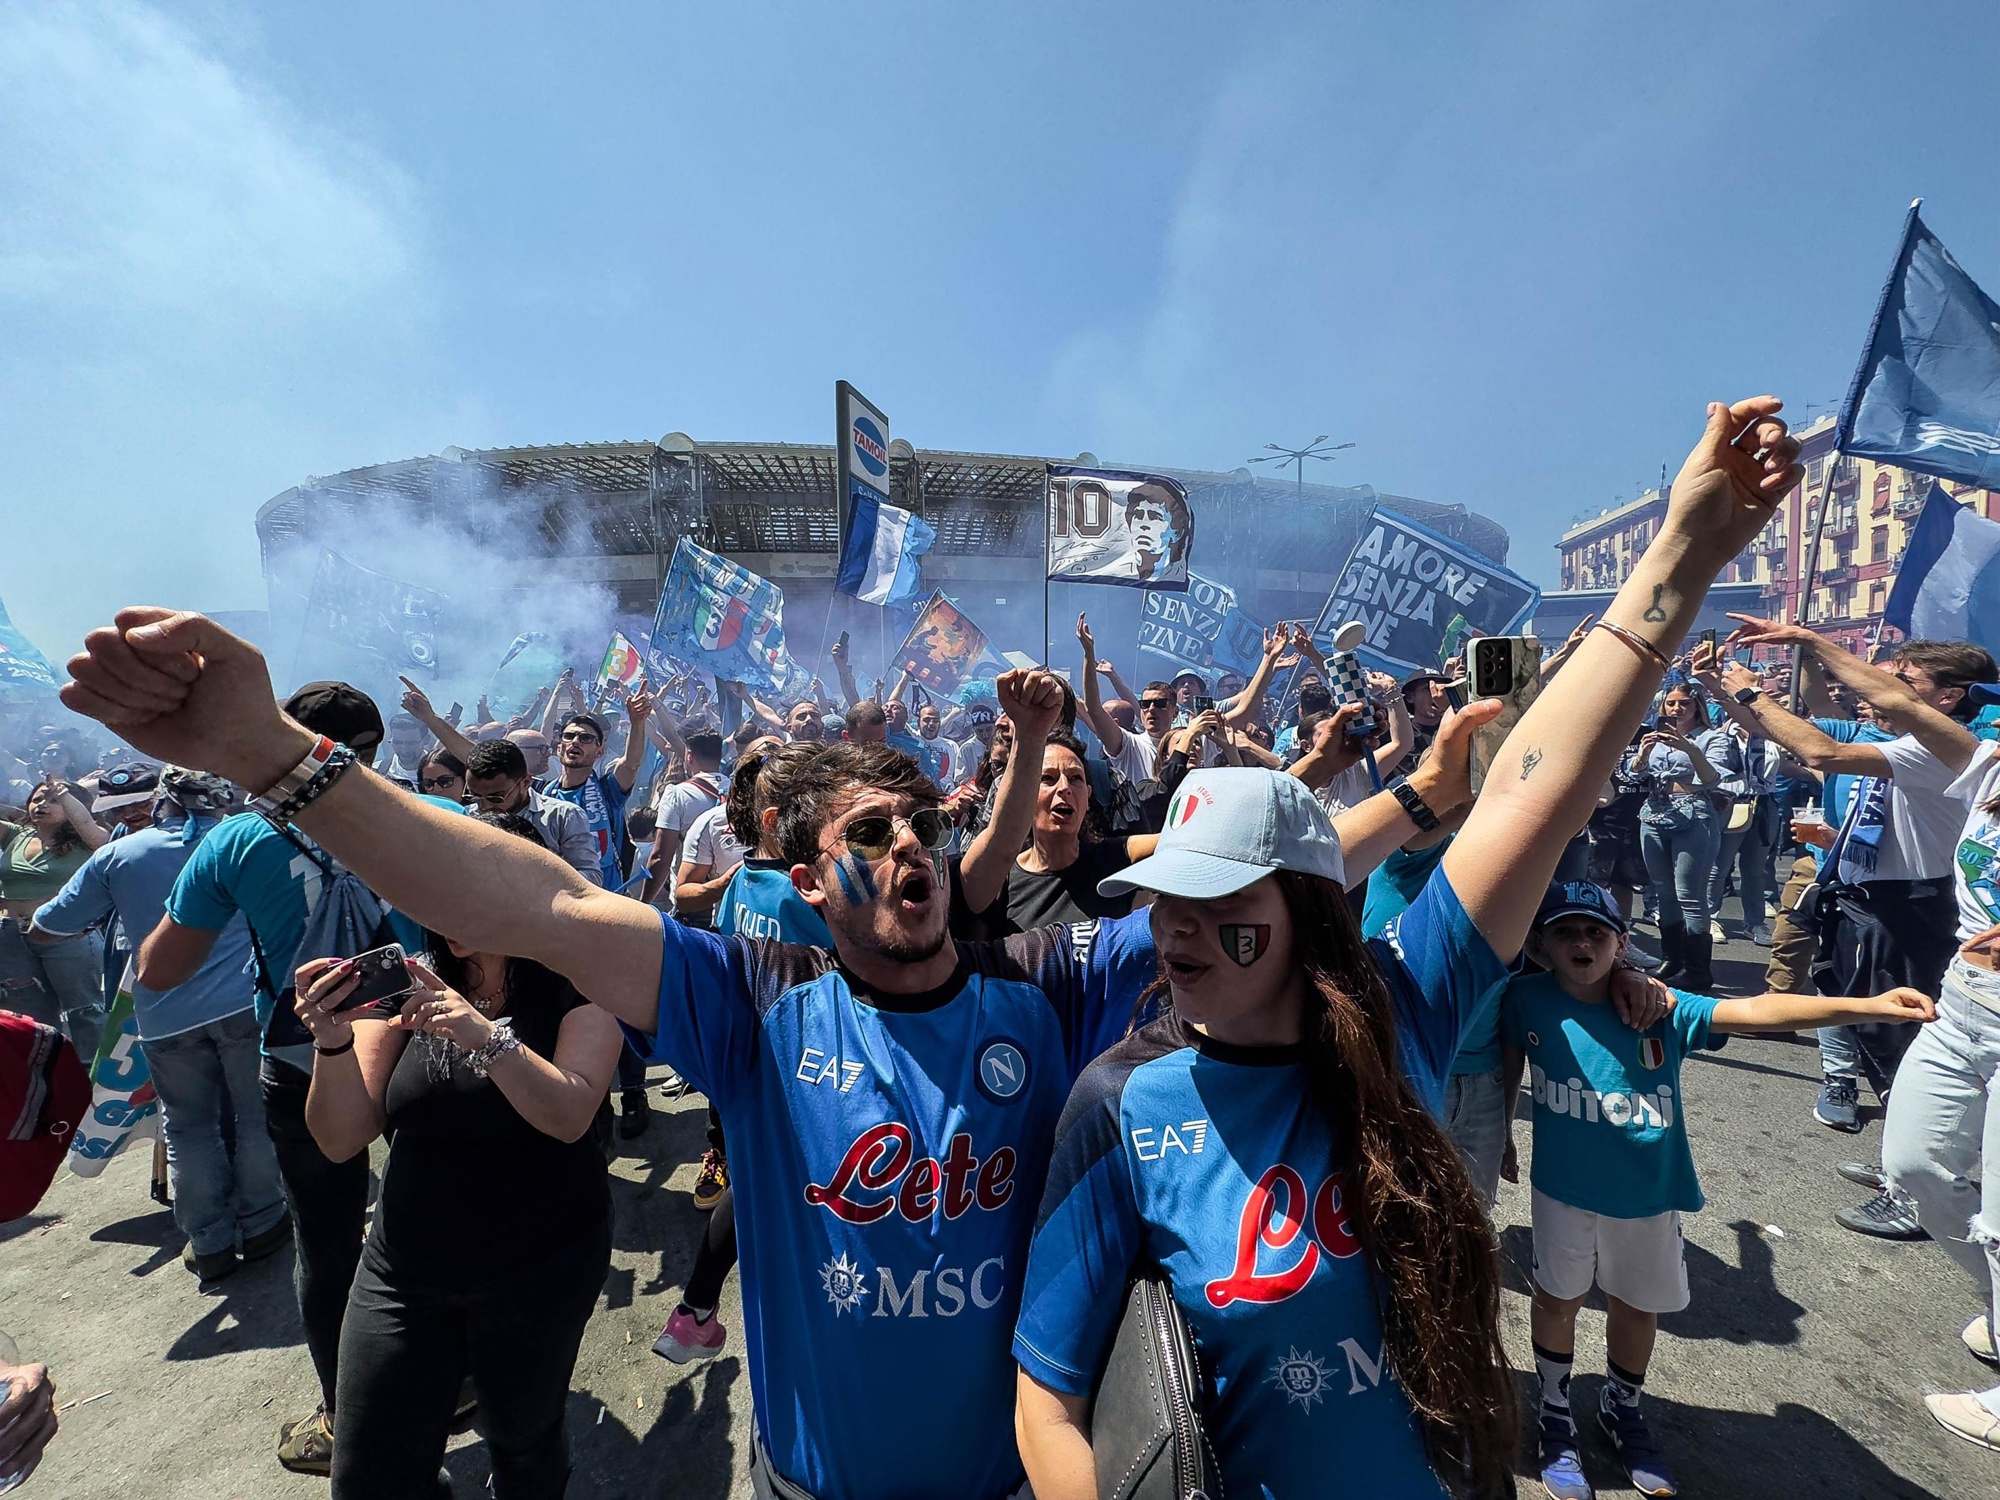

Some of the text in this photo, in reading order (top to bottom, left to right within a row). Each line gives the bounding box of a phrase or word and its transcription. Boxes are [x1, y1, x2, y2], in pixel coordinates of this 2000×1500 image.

[853, 428, 887, 465] TAMOIL
[1049, 478, 1112, 538] 10
[1355, 525, 1488, 606] AMORE
[1147, 591, 1222, 641] SENZ
[1338, 562, 1436, 627] SENZA
[706, 612, 722, 639] 3
[1140, 621, 1203, 661] FINE
[1318, 599, 1399, 650] FINE
[606, 649, 629, 677] 3
[1240, 935, 1253, 954] 3
[796, 1047, 865, 1093] EA7
[987, 1051, 1016, 1088] N
[1131, 1119, 1208, 1161] EA7
[804, 1122, 1017, 1225] Lete
[1204, 1163, 1363, 1309] Le
[871, 1255, 1005, 1318] MSC
